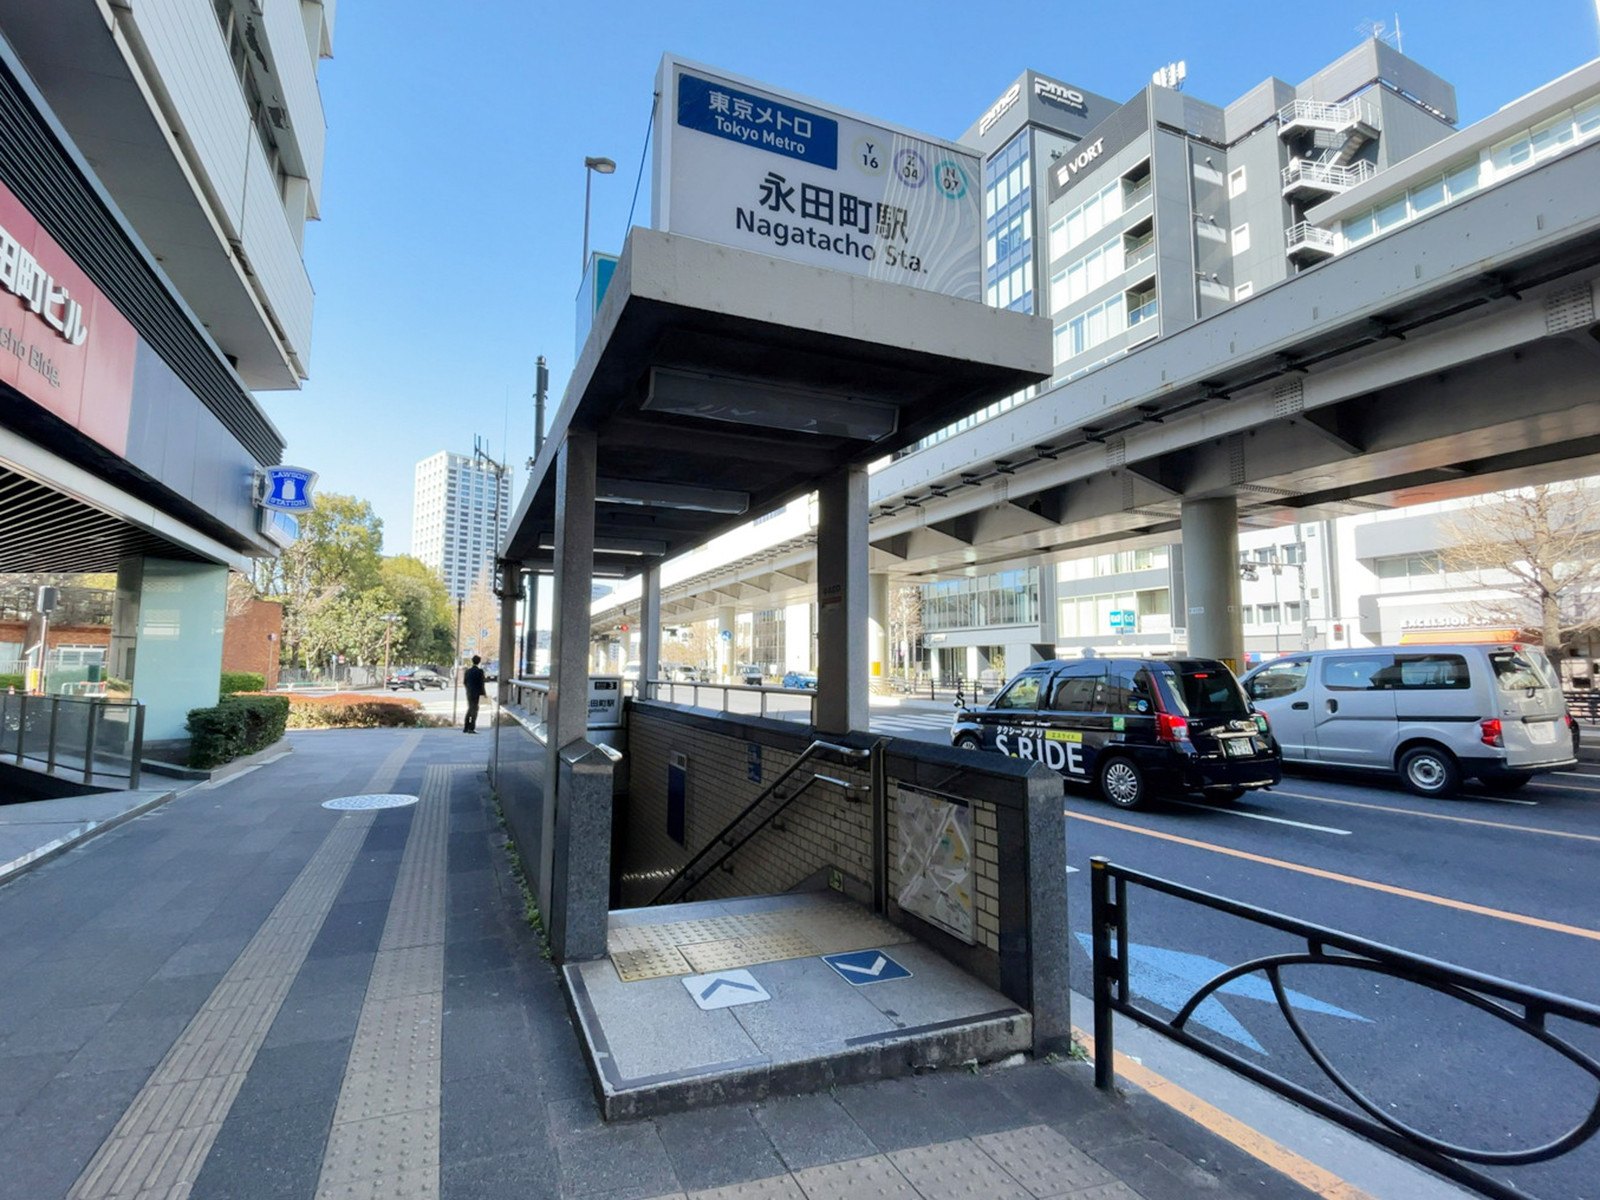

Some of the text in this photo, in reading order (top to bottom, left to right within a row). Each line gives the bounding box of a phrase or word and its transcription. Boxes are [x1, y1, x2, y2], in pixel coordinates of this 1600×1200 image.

[708, 90, 812, 139] 東京メトロ
[715, 115, 806, 155] Tokyo Metro
[866, 142, 874, 154] Y
[862, 154, 879, 169] 16
[1069, 137, 1104, 174] VORT
[759, 171, 909, 243] 永田町駅
[735, 206, 928, 275] Nagatacho Sta.
[272, 471, 308, 482] LAWSON
[270, 497, 306, 507] STATION
[996, 725, 1043, 738] タクシーアプリ
